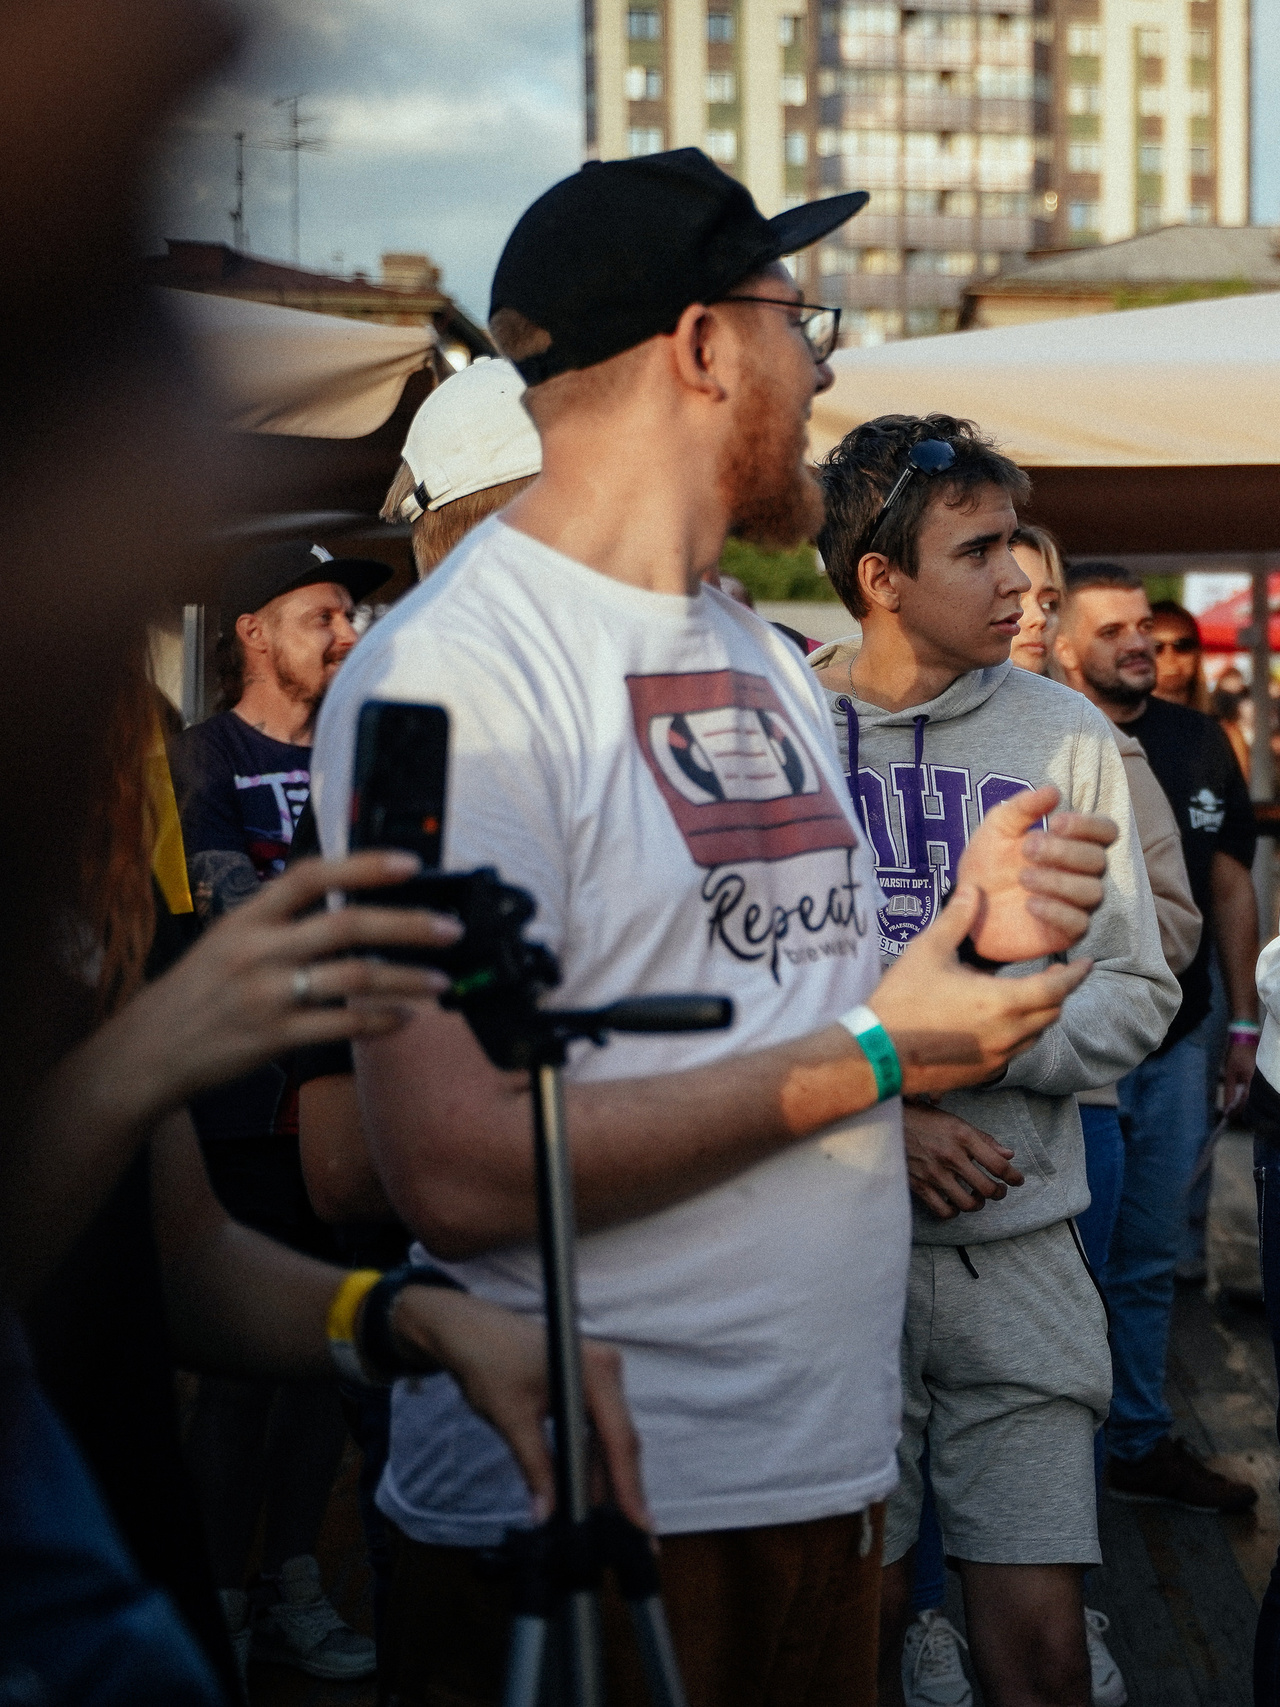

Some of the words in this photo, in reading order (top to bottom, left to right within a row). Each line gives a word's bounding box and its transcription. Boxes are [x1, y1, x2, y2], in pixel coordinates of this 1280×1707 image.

[702, 848, 868, 987] Repeat
[879, 877, 911, 889] VARSITY
[912, 878, 932, 889] DPT.
